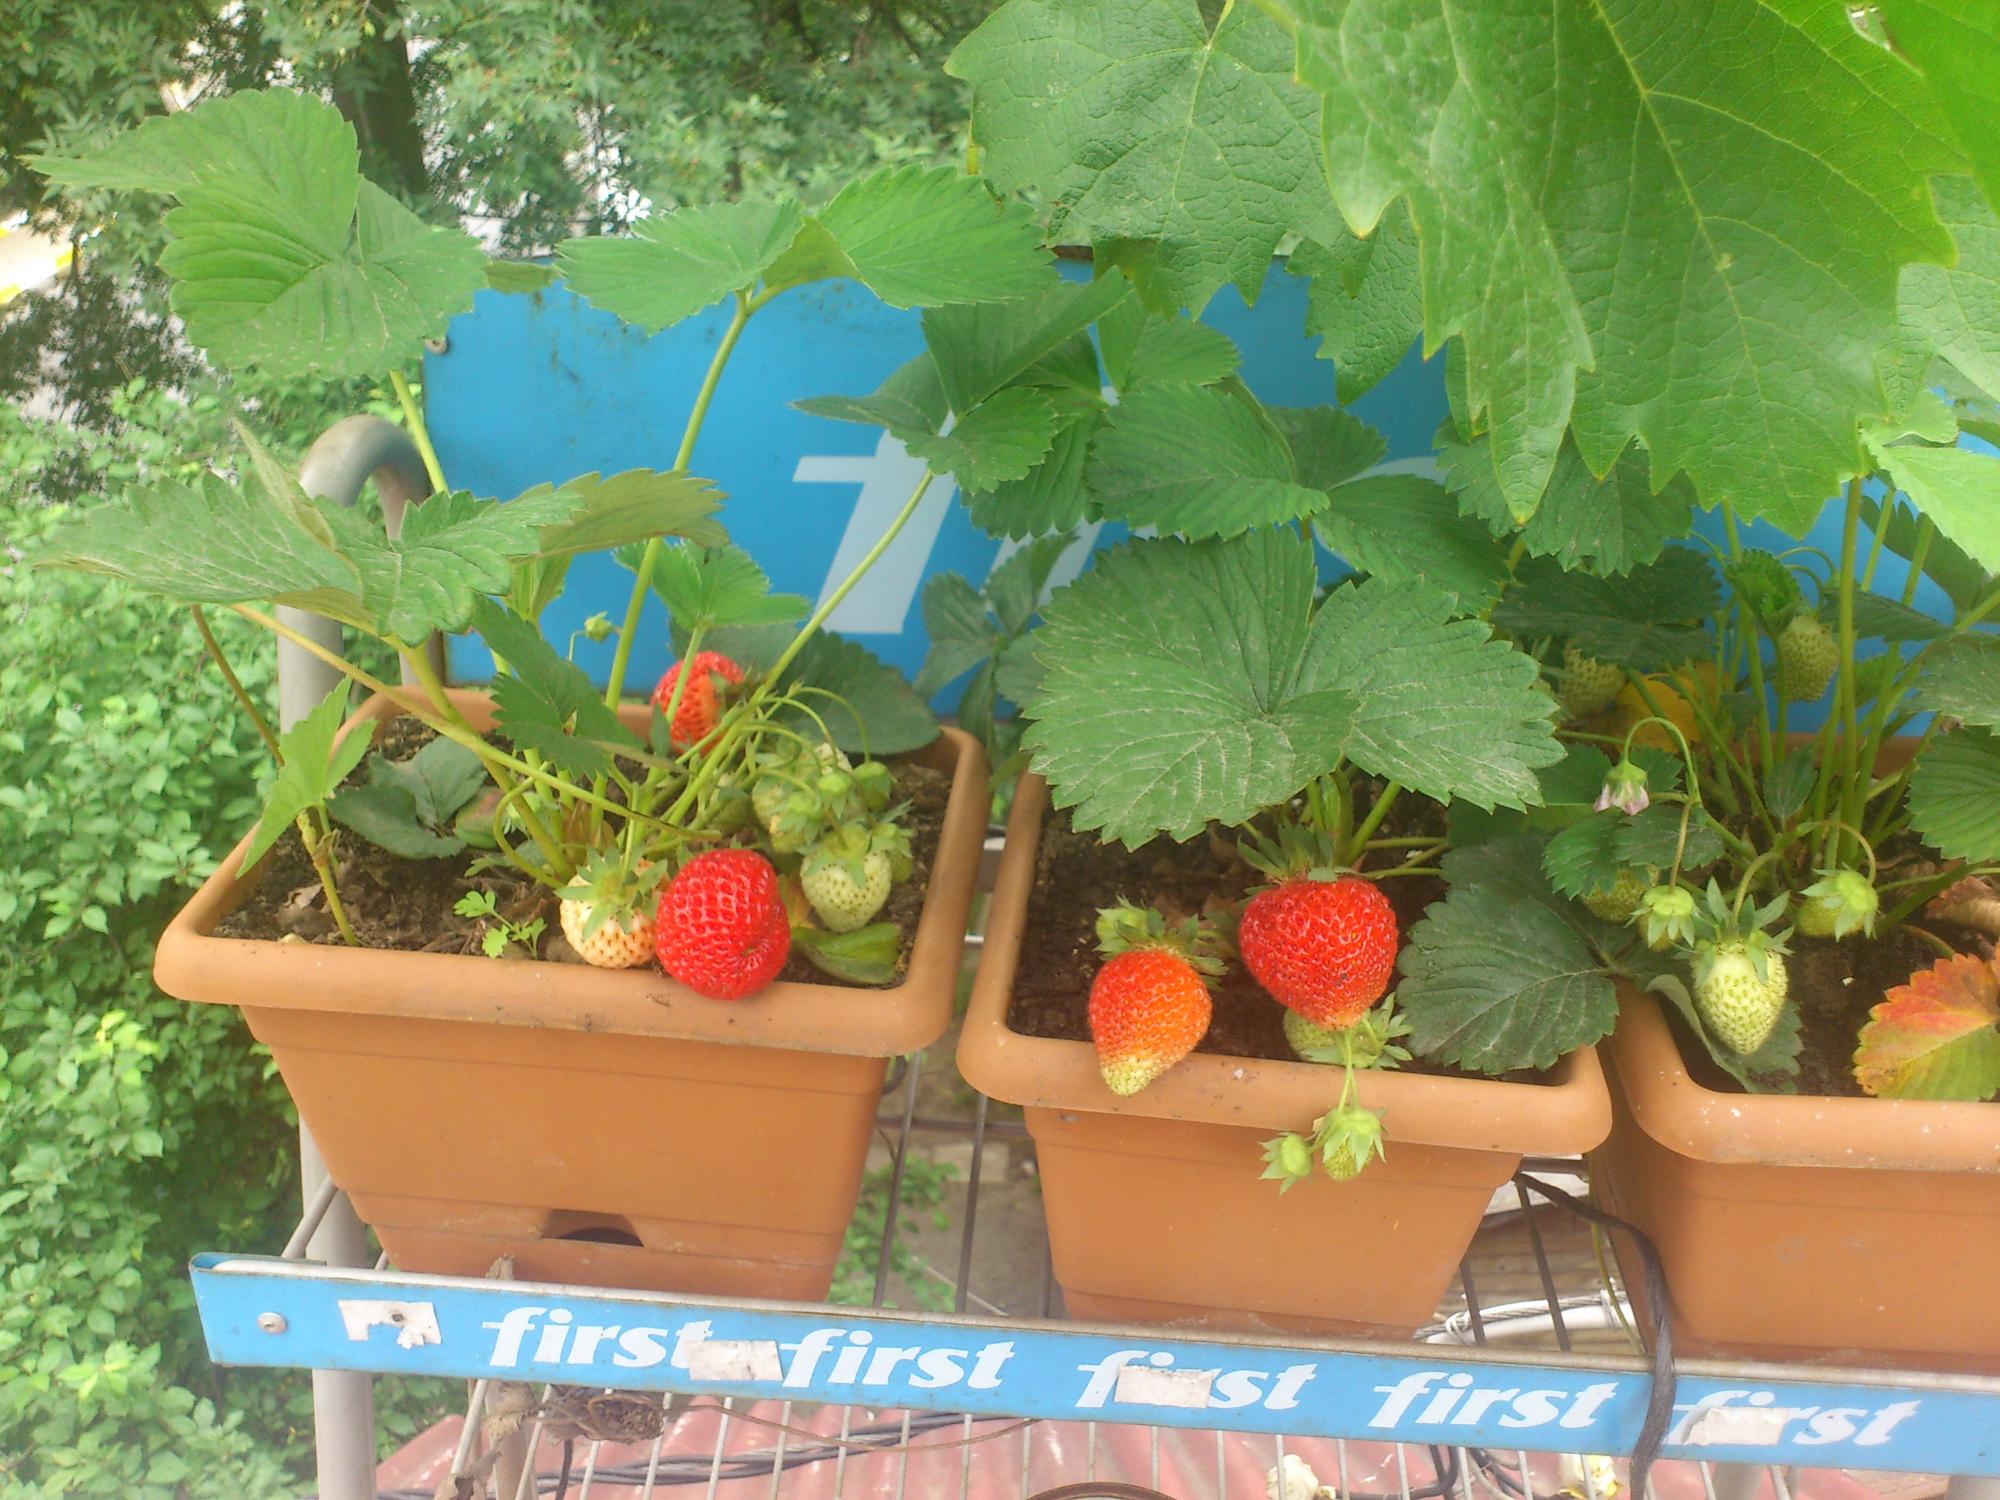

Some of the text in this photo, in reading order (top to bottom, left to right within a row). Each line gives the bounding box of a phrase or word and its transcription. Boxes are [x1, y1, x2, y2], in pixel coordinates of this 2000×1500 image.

[482, 1306, 714, 1368] first
[779, 1328, 1015, 1388] first
[1367, 1372, 1619, 1428] first
